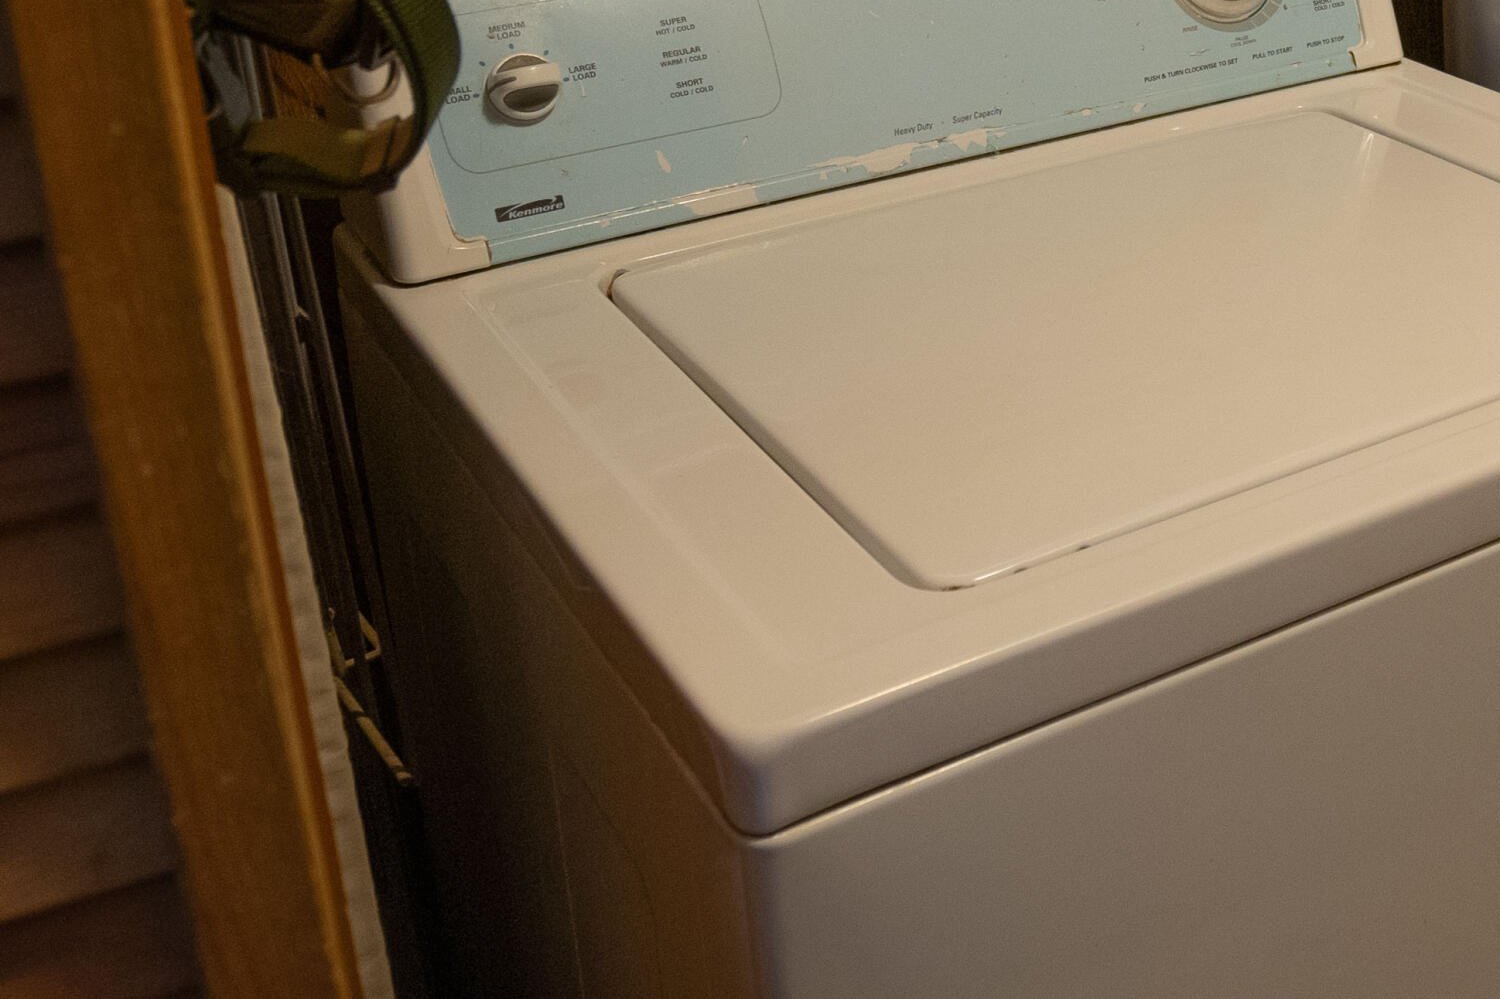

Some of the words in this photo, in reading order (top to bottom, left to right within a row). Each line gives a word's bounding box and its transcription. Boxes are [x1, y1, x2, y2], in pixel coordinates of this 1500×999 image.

[488, 21, 526, 35] MEDIUM
[659, 16, 688, 28] SUPER
[496, 29, 521, 41] LOAD
[655, 27, 672, 37] HOT
[676, 23, 696, 34] COLD
[1306, 39, 1322, 49] PUSH
[1331, 35, 1346, 45] STOP
[662, 46, 702, 59] REGULAR
[1252, 50, 1267, 61] PULL
[1275, 45, 1294, 56] START
[659, 57, 684, 69] WARM
[688, 53, 709, 64] COLD
[568, 62, 598, 75] LARGE
[1143, 73, 1161, 84] PUSH
[1168, 68, 1185, 79] TURN
[1184, 61, 1218, 75] CLOCKWISE
[572, 70, 597, 82] LOAD
[676, 77, 705, 90] SHORT
[448, 85, 473, 97] MALL
[669, 88, 690, 99] COLD
[694, 84, 715, 95] COLD
[446, 93, 471, 105] LOAD
[894, 125, 916, 137] Heavy
[917, 122, 935, 133] Duty
[951, 114, 973, 125] Super
[973, 105, 1003, 120] Capacity
[508, 201, 564, 220] Kenmore
